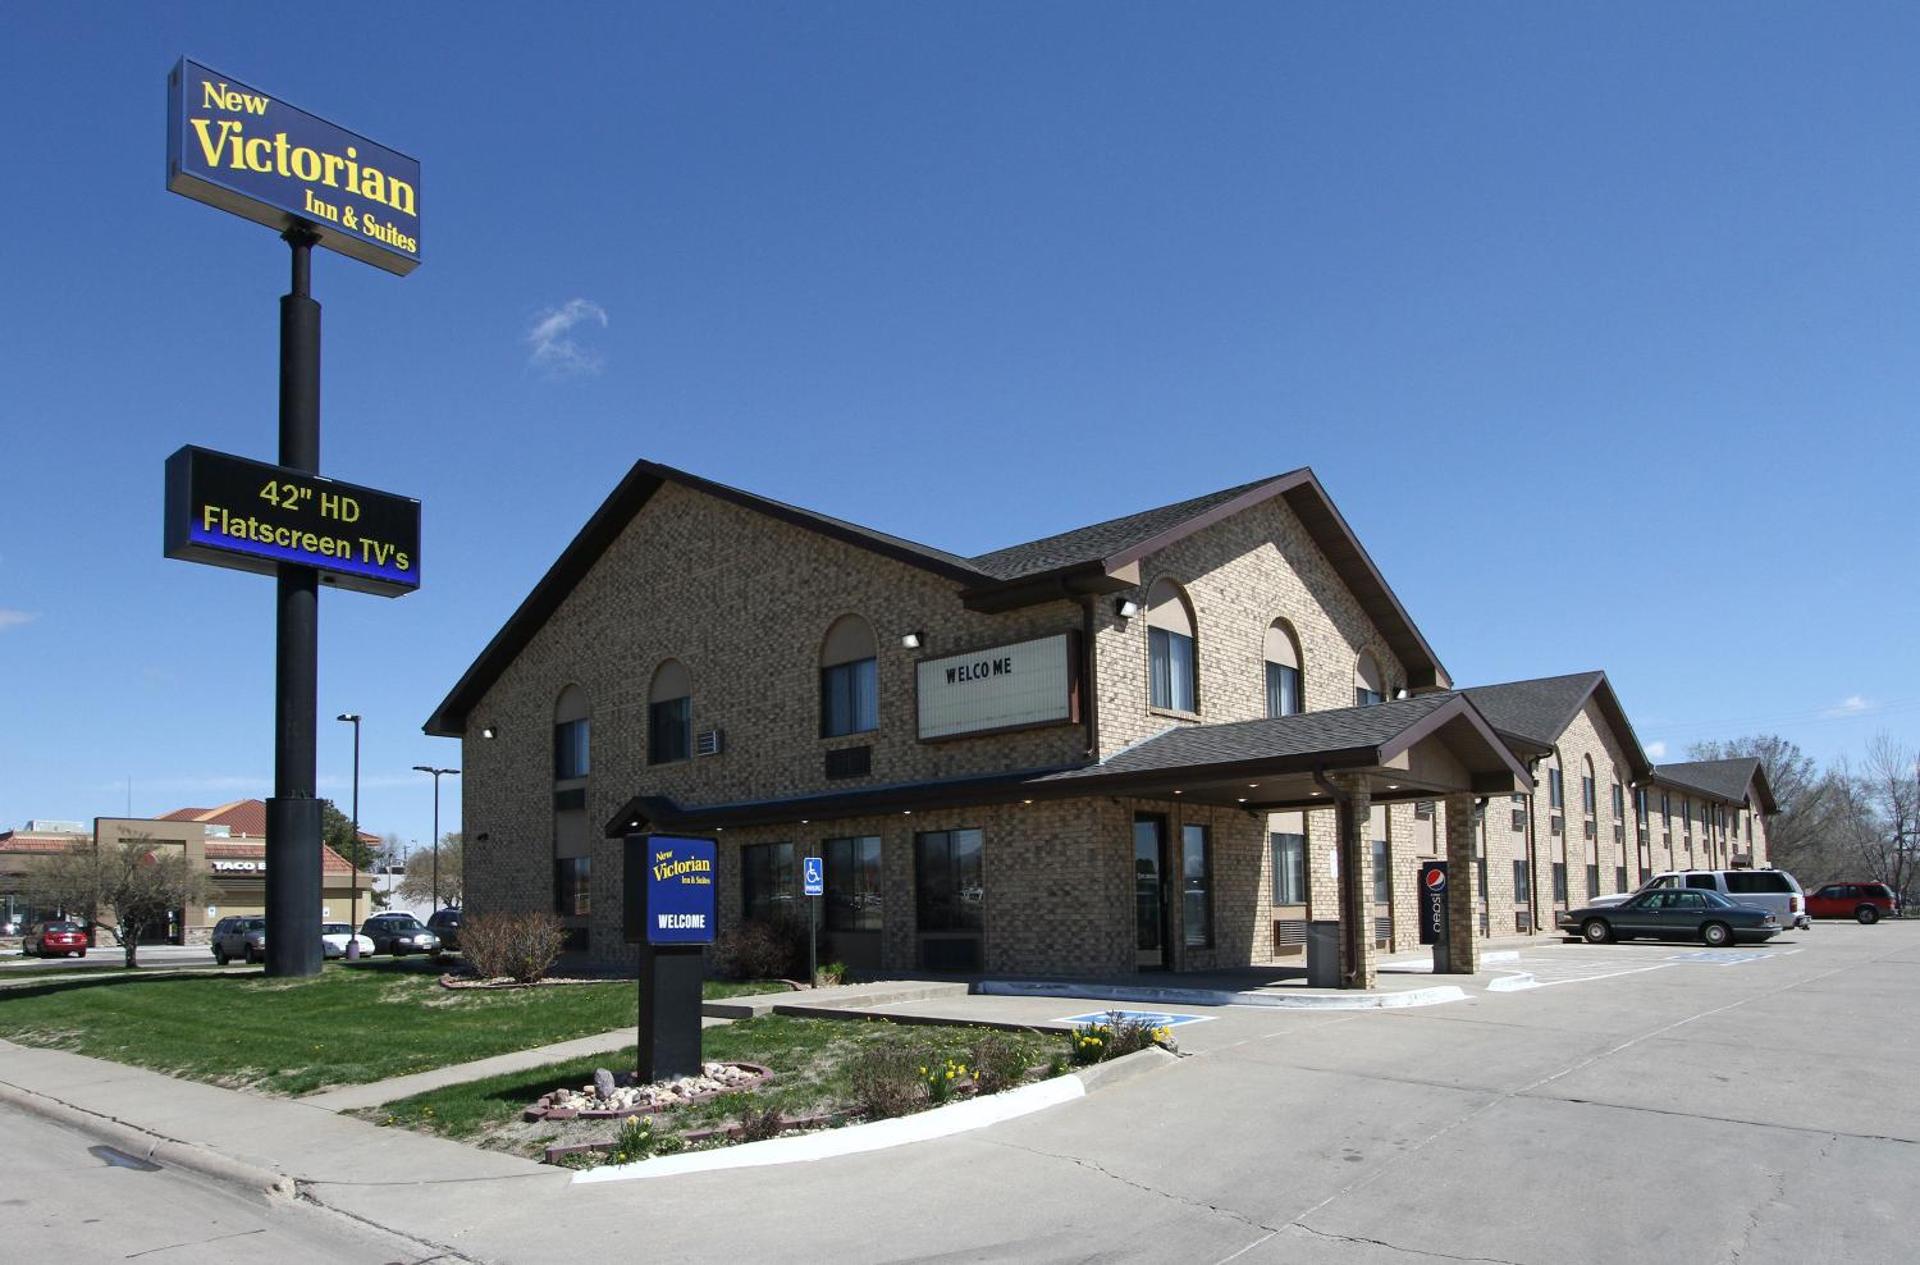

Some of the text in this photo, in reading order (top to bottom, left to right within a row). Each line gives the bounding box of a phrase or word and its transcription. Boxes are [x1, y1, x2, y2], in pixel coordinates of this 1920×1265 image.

[202, 81, 269, 115] New
[190, 119, 416, 216] Victorian
[304, 189, 416, 253] Inn & Suites
[259, 481, 360, 523] 42" HD
[203, 505, 409, 571] Flatscreen TV's
[946, 657, 1012, 684] WELCOME
[212, 861, 256, 870] TACO
[653, 856, 710, 881] Victorian
[656, 851, 672, 862] New
[658, 914, 705, 929] WELCOME
